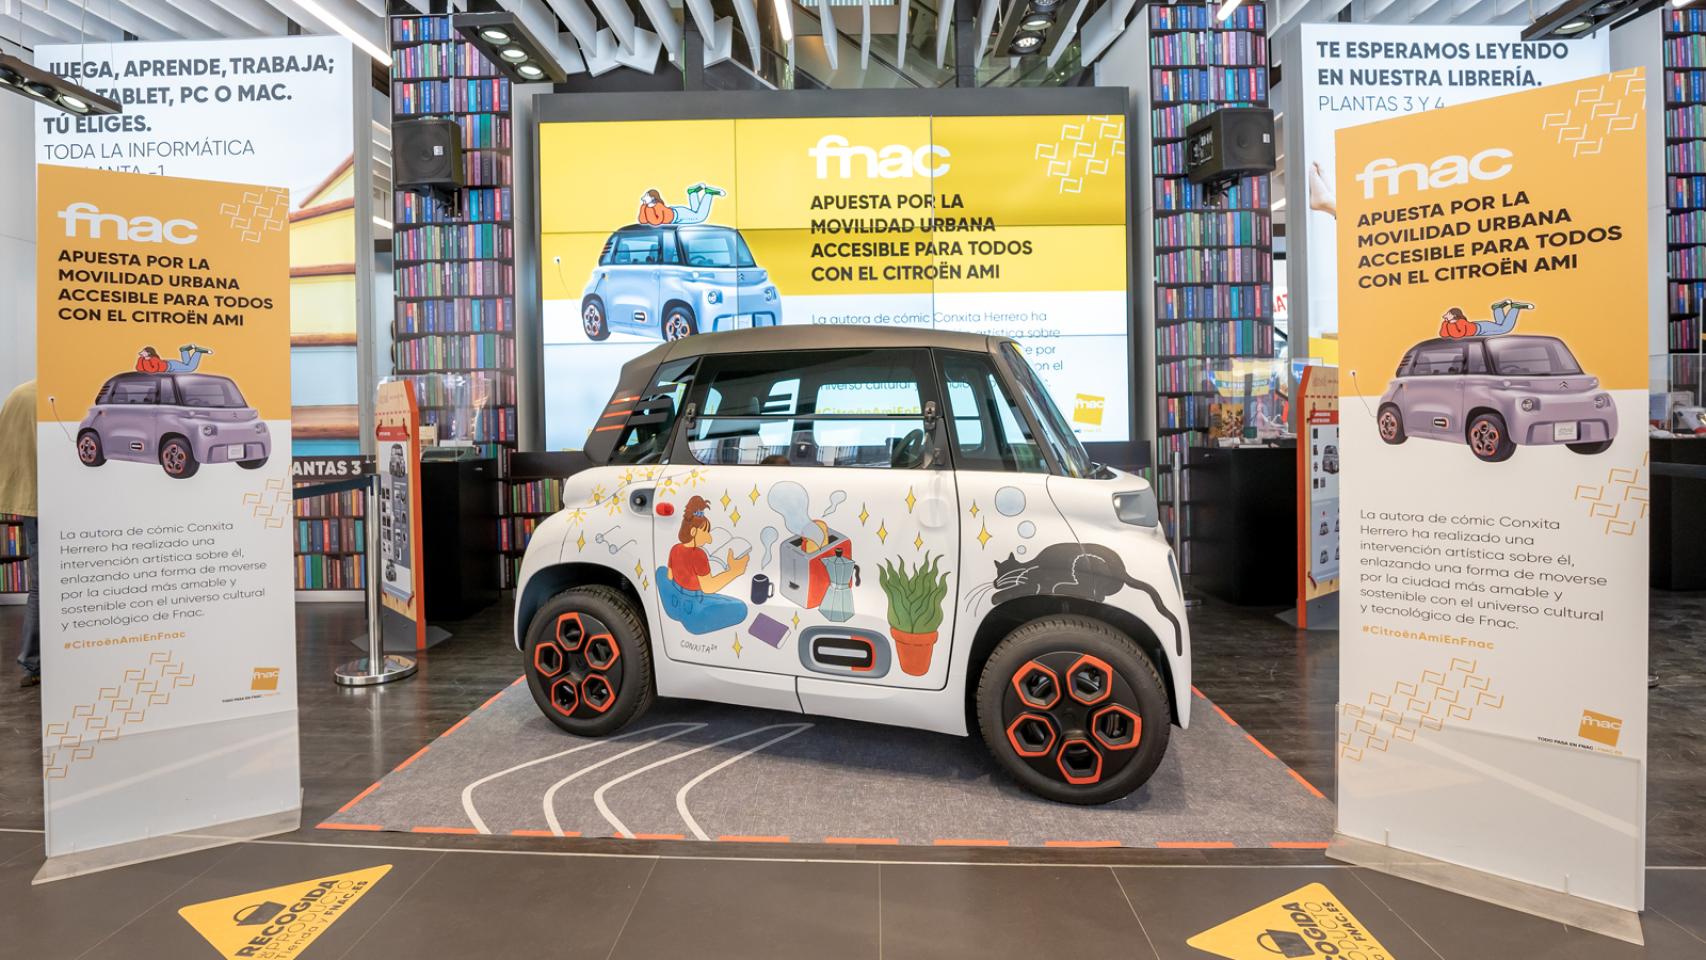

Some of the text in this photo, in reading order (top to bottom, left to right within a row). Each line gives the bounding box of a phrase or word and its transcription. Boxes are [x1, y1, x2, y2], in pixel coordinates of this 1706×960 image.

[1317, 41, 1568, 59] TE ESPERAMOS LEYENDO
[124, 59, 227, 77] APRENDE,
[230, 55, 334, 74] TRABAJA;
[1318, 66, 1542, 86] EN NUESTRA LIBRERÍA.
[181, 86, 208, 103] PC
[215, 85, 231, 102] O
[238, 84, 292, 101] MAC.
[1319, 96, 1444, 111] PLANTAS 3 Y 4
[43, 113, 151, 134] TÚ ELIGES.
[43, 137, 255, 159] TODA LA INFORMÁTICA
[808, 135, 950, 179] fnac
[1356, 148, 1513, 199] fnac
[810, 194, 963, 209] APUESTA POR LA
[1357, 191, 1529, 227] APUESTA POR LA
[57, 202, 198, 244] fnac
[811, 217, 995, 234] MOVILIDAD URBANA
[1358, 208, 1571, 248] MOVILIDAD URBANA
[811, 241, 1032, 257] ACCESIBLE PARA TODOS
[1358, 225, 1622, 269] ACCESIBLE PARA TODOS
[58, 250, 209, 270] APUESTA POR LA
[59, 269, 239, 290] MOVILIDAD URBANA
[812, 262, 999, 281] CON EL CITROËN AMI
[1359, 253, 1577, 289] CON EL CITROËN AMI
[58, 289, 273, 309] ACCESIBLE PARA TODOS
[58, 308, 243, 326] CON EL CITROËN AMI
[812, 312, 1046, 324] La autora de cómic Conxita Herrero ha
[1028, 328, 1060, 337] sobre
[1035, 346, 1055, 357] por
[1053, 360, 1062, 370] el
[292, 461, 361, 475] ANTAS 3
[1361, 510, 1560, 530] La autora de cómic Conxita
[60, 522, 233, 540] La autora de cómic Conxita
[1361, 526, 1534, 545] Herrero ha realizado una
[60, 537, 215, 555] Herrero ha realizado una
[1361, 541, 1574, 567] intervención artística sobre él,
[60, 548, 244, 569] intervención artística sobre él,
[60, 562, 267, 584] enlazando una forma de moverse
[1361, 557, 1607, 586] enlazando una forma de moverse
[61, 578, 236, 602] por la ciudad más amable y
[1361, 572, 1563, 601] por la ciudad más amable y
[61, 588, 264, 615] sostenible con el universo cultural
[1361, 588, 1604, 621] sostenible con el universo cultural
[61, 621, 69, 632] y
[73, 614, 149, 629] tecnológico
[153, 611, 169, 621] de
[1361, 604, 1518, 629] y tecnológico de Fnac.
[64, 632, 186, 649] #CitroënAmiEnFnac
[1362, 625, 1494, 650] #CitroënAmiEnFnac
[235, 880, 340, 957] RECOGIDA
[266, 880, 353, 951] PRODUCTO
